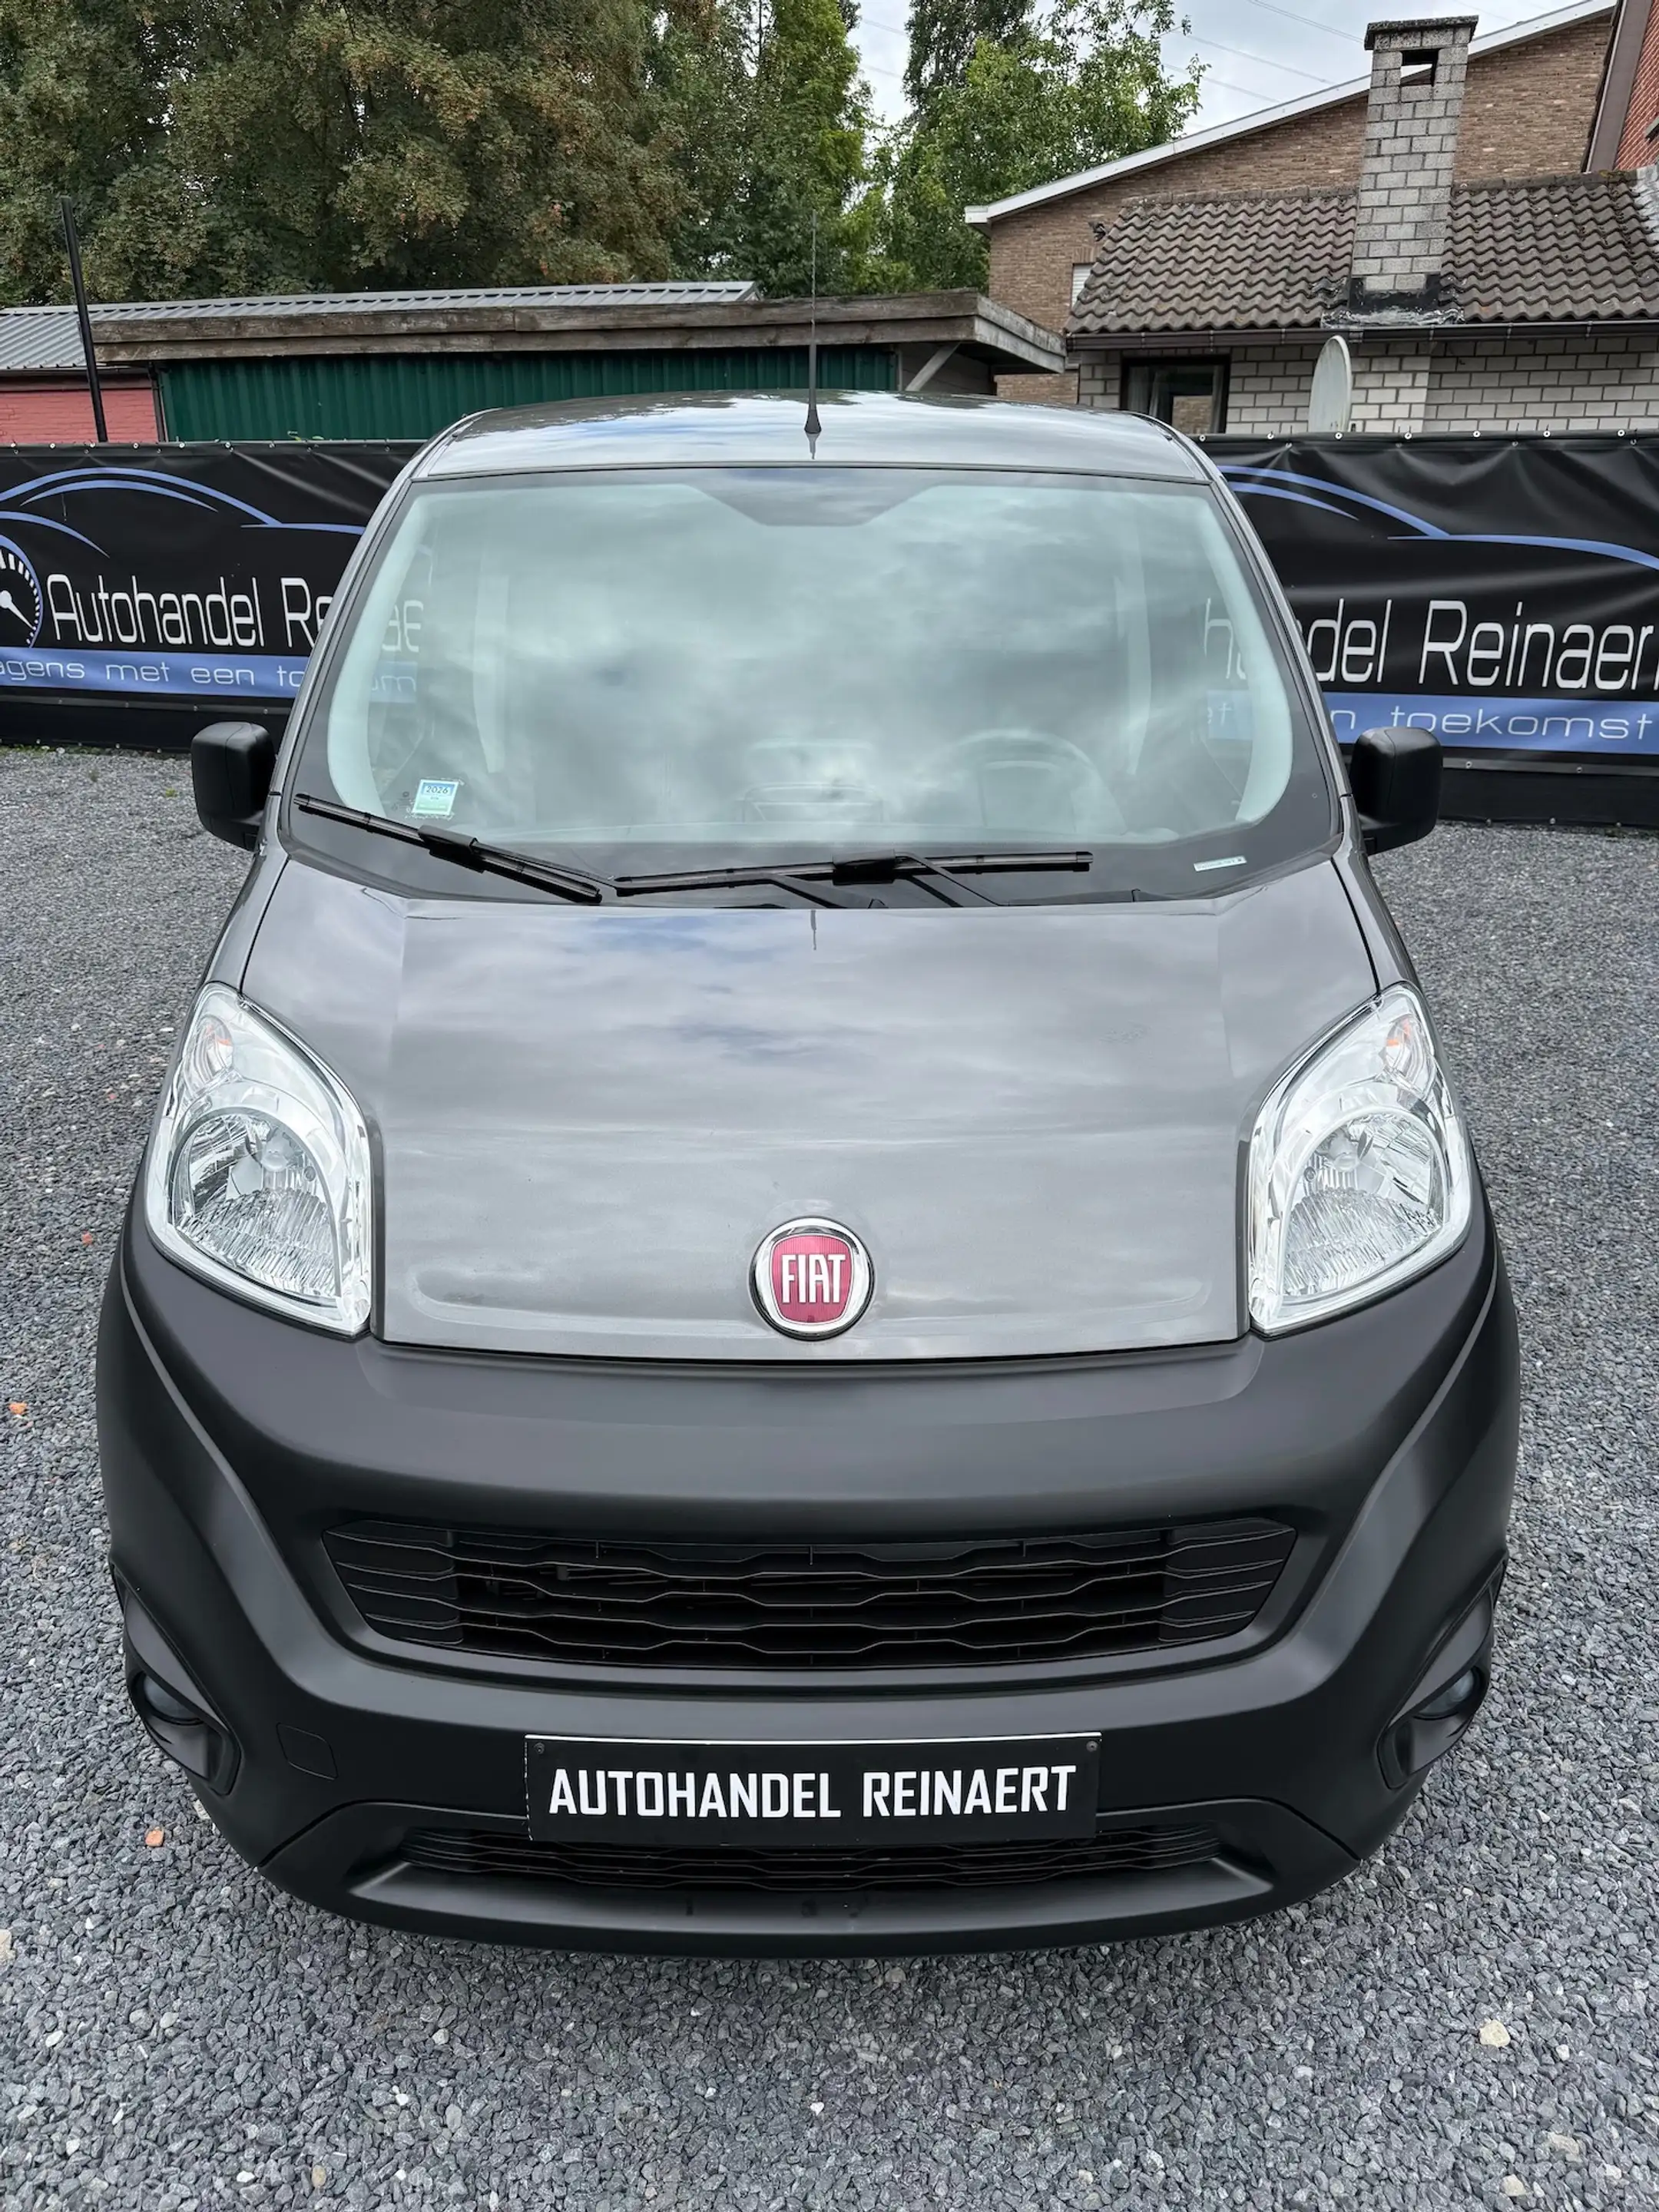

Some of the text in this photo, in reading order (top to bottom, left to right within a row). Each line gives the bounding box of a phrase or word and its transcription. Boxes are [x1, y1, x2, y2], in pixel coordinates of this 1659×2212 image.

[47, 573, 264, 647] Autohandel
[1418, 600, 1659, 690] Reinaer
[106, 662, 170, 682] met
[190, 667, 255, 686] een
[1390, 705, 1652, 740] toekomst
[782, 1254, 846, 1303] FIAT
[548, 1765, 1076, 1817] AUTOHANDEL REINAERT
